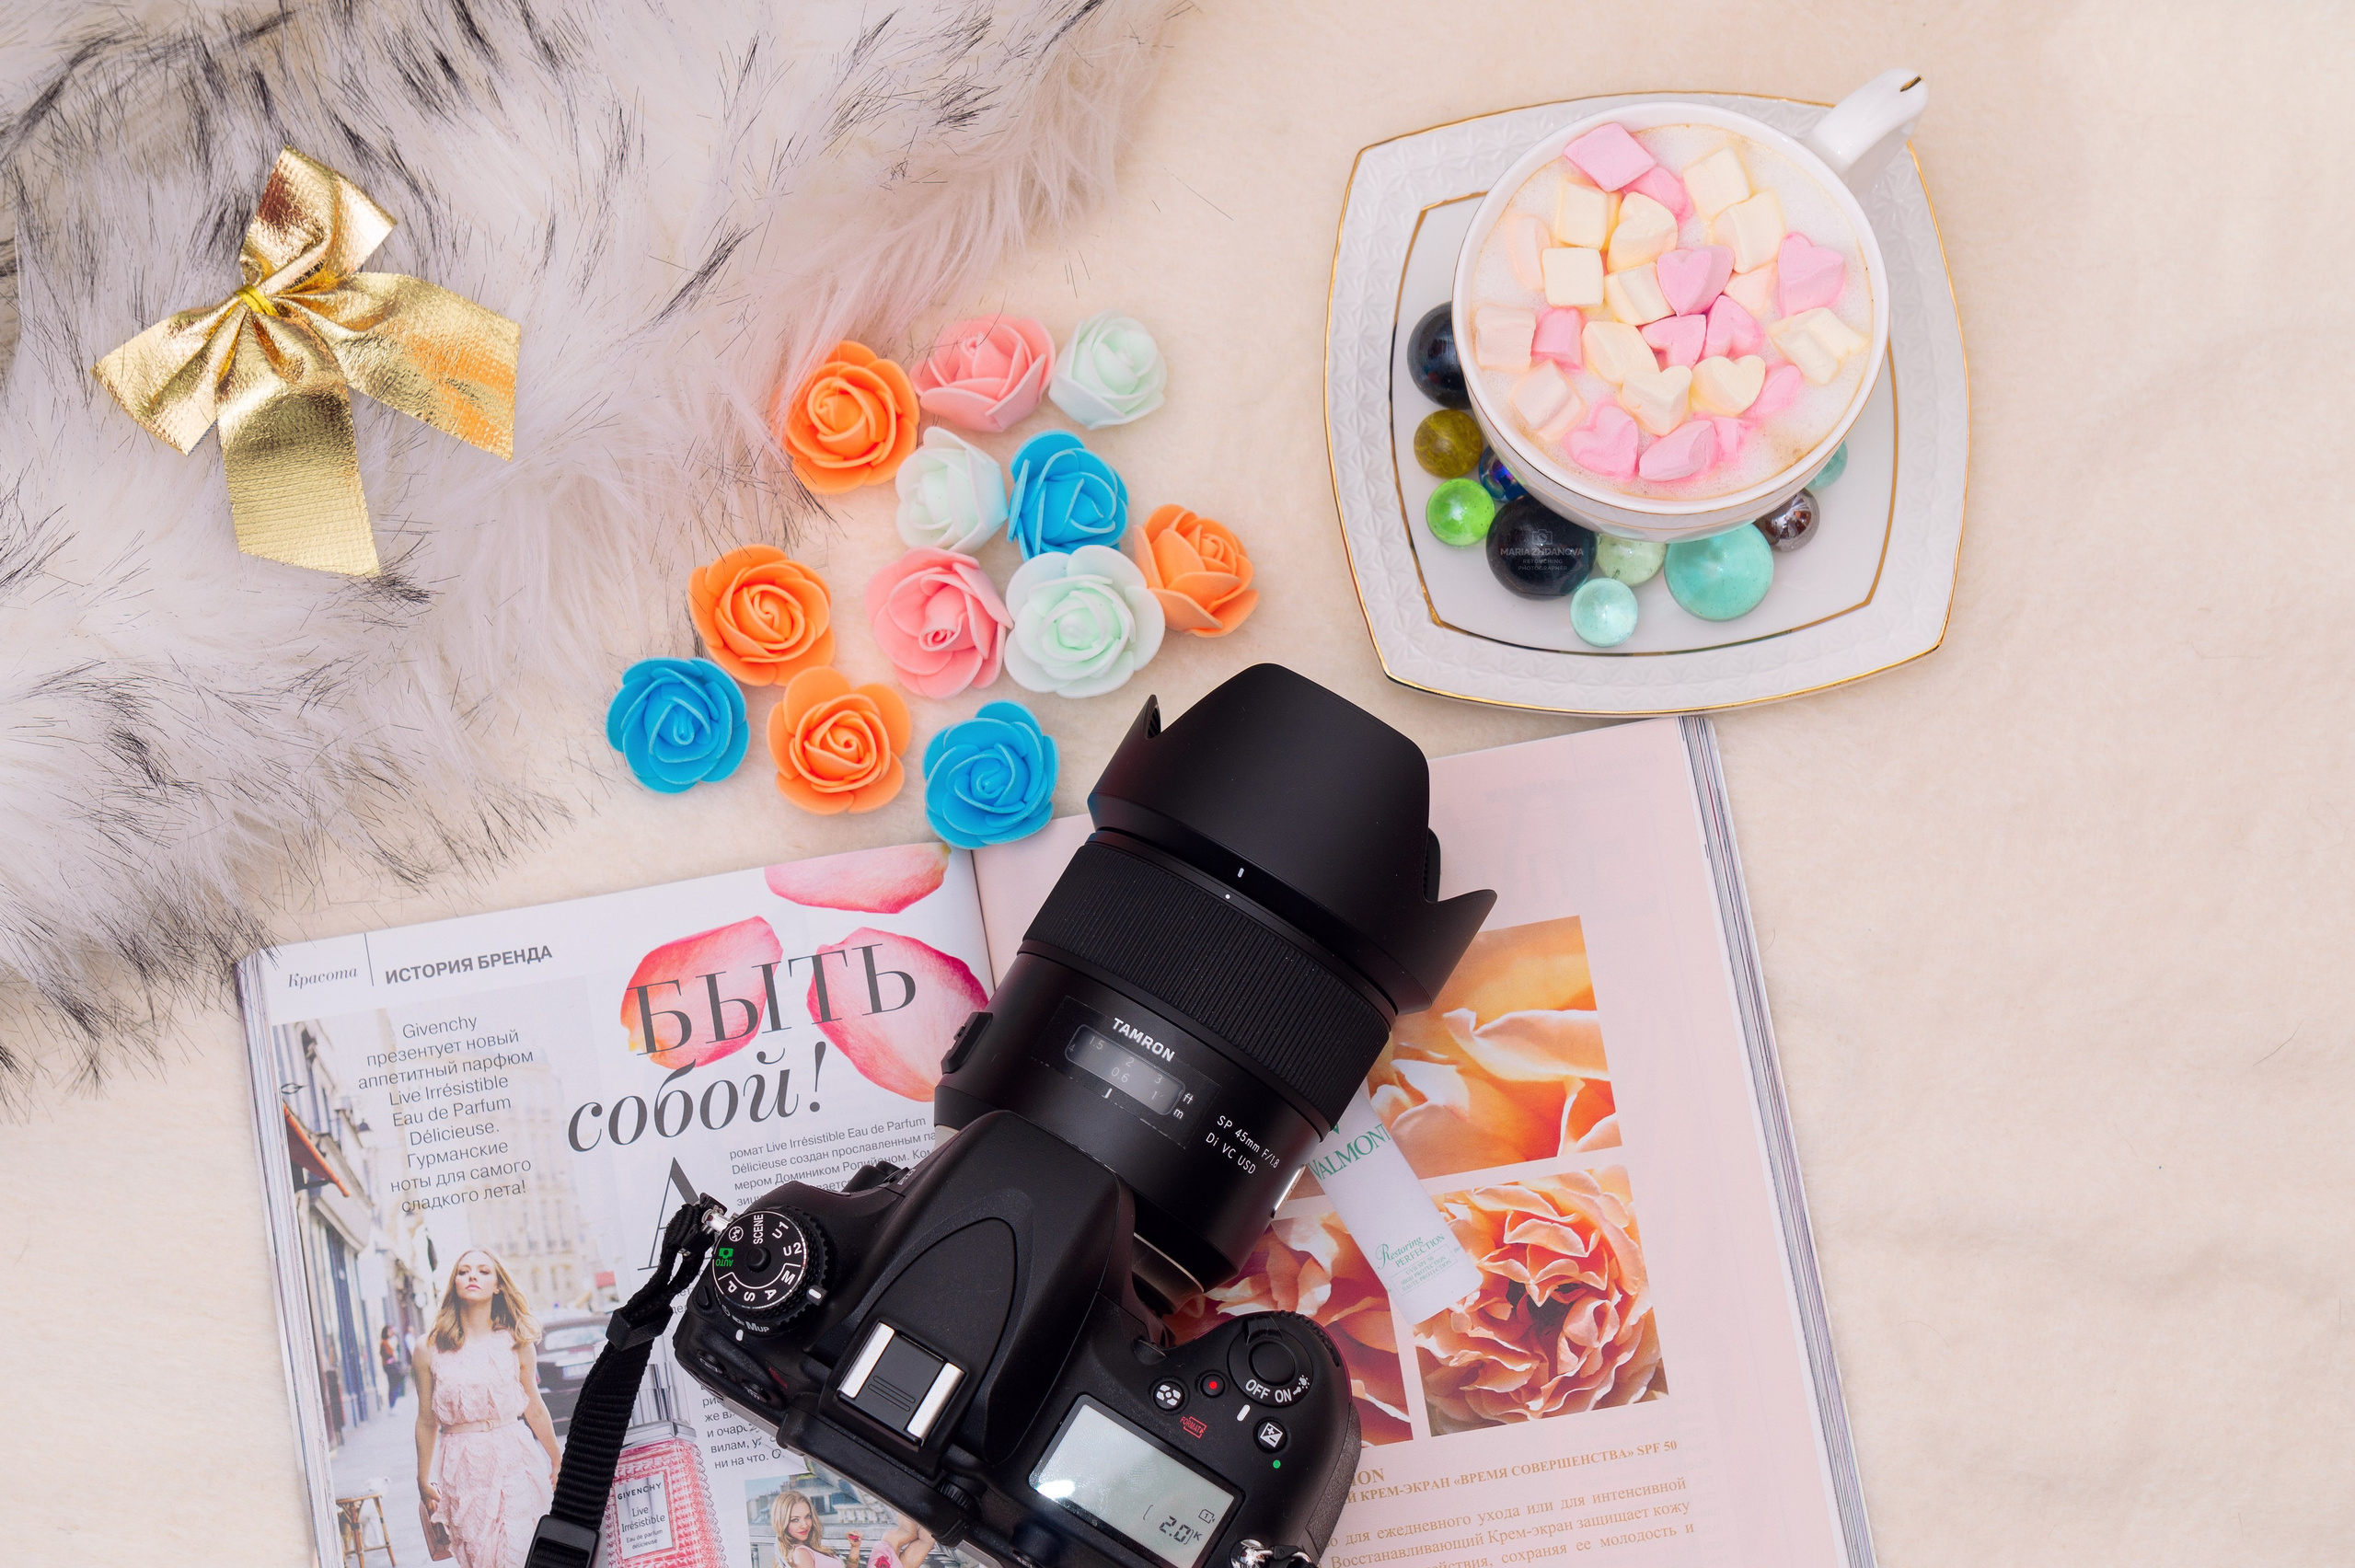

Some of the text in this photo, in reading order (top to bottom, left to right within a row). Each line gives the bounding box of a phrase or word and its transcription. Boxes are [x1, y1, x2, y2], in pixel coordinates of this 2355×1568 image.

[288, 968, 358, 989] Красота
[385, 945, 553, 985] ИСТОРИЯ БРЕНДА
[626, 943, 917, 1056] БЫТЬ
[402, 1016, 477, 1039] Givenchy
[1112, 1017, 1175, 1062] TAMRON
[366, 1029, 519, 1067] презентует новый
[358, 1051, 534, 1090] аппетитный парфюм
[1089, 1035, 1194, 1105] 1.5 2 3 ft
[388, 1075, 509, 1105] Live Irrésistible
[567, 1041, 826, 1153] собой!
[1111, 1066, 1130, 1083] 0.6
[1172, 1108, 1183, 1120] m
[392, 1097, 512, 1127] Eau de Parfum
[410, 1122, 500, 1146] Délicieuse.
[729, 1117, 927, 1160] ромат Live Irrésistible Eau de Parfum
[1217, 1114, 1280, 1169] SP 45mm F/1.8
[407, 1141, 509, 1170] Гурманские
[732, 1132, 936, 1175] Délicieuse создан прославленным па
[1205, 1132, 1256, 1174] Di VC USD
[390, 1159, 532, 1193] ноты для самого
[734, 1178, 772, 1191] мером
[774, 1165, 840, 1185] Домиником
[401, 1180, 526, 1213] сладкого лета!
[753, 1214, 764, 1245] SCENE
[771, 1221, 790, 1239] U1
[715, 1258, 733, 1267] AUTO
[782, 1242, 802, 1257] U2
[1375, 1237, 1424, 1270] Restoring
[1394, 1233, 1445, 1268] PERFECTION
[727, 1280, 738, 1294] P
[781, 1270, 796, 1286] M
[744, 1291, 756, 1302] S
[764, 1288, 778, 1300] A
[1245, 1378, 1292, 1403] OFF ON
[704, 1412, 720, 1423] же
[1180, 1416, 1201, 1433] FORMAT
[707, 1430, 714, 1438] и
[714, 1460, 729, 1470] ни
[731, 1457, 745, 1466] на
[746, 1453, 769, 1463] что.
[1360, 1477, 1450, 1502] КРЕМ-ЭКРАН
[1453, 1467, 1507, 1486] «ВРЕМЯ
[1511, 1448, 1634, 1477] СОВЕРШЕНСТВА»
[1636, 1442, 1660, 1456] SPF
[1663, 1440, 1678, 1452] 50
[618, 1482, 662, 1500] GIVENCHY
[621, 1515, 666, 1533] Irrésistible
[631, 1506, 649, 1517] Live
[1345, 1531, 1370, 1546] для
[1377, 1515, 1472, 1539] ежедневного
[1477, 1506, 1520, 1526] ухода
[1527, 1501, 1553, 1515] или
[1560, 1495, 1586, 1511] для
[1592, 1476, 1687, 1505] интенсивной
[1331, 1501, 1691, 1568] Восстанавливающий Крем-экран защищает кожу
[1501, 1544, 1567, 1564] сохраняя
[1576, 1539, 1591, 1551] ее
[1599, 1526, 1677, 1549] молодость
[1685, 1523, 1694, 1534] и
